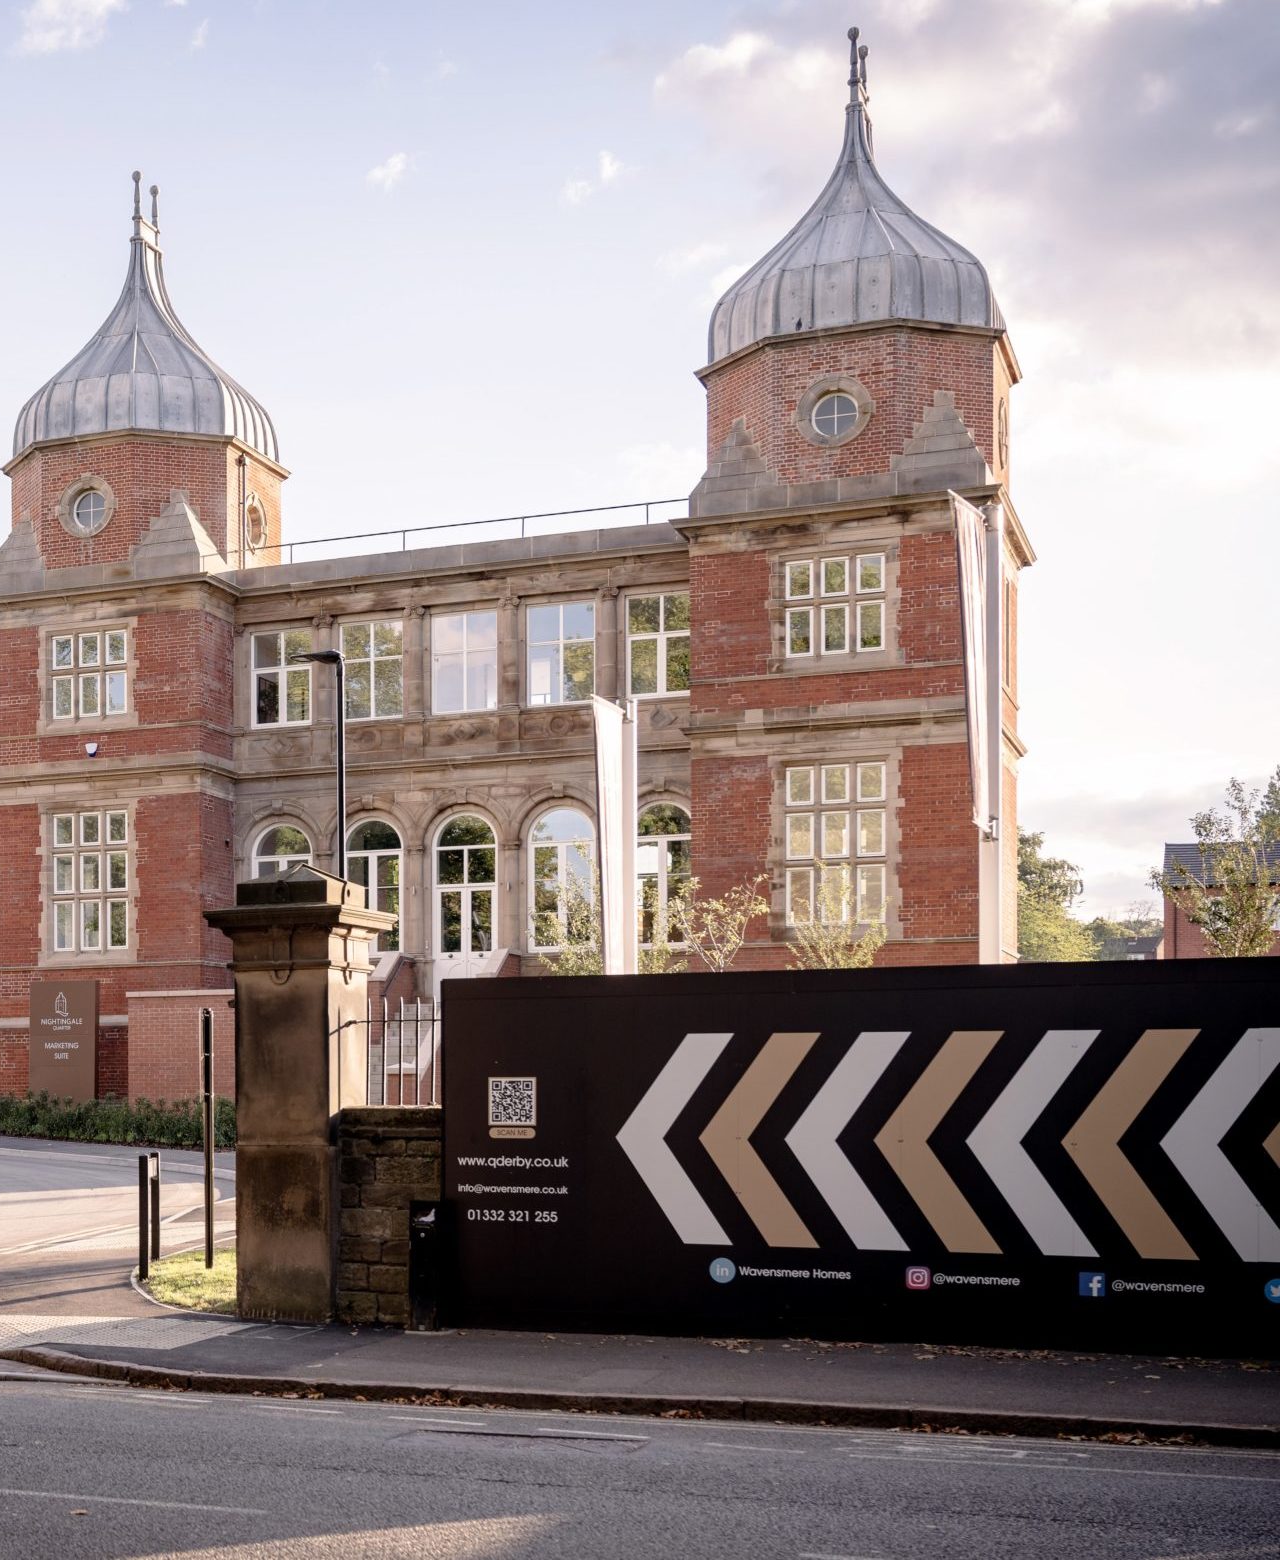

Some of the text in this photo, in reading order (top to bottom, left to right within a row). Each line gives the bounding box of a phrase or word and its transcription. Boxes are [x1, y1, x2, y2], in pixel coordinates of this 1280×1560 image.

[40, 1018, 83, 1026] NIGHTINGALE
[457, 1156, 569, 1169] www.qderby.co.uk
[457, 1183, 569, 1195] info@wavensmere.co.uk
[467, 1209, 559, 1222] 01332 321 255
[739, 1265, 810, 1279] Wavensmere
[812, 1268, 852, 1280] Homes
[932, 1272, 1020, 1287] @wavensmere
[1111, 1279, 1205, 1294] @wavensmere
